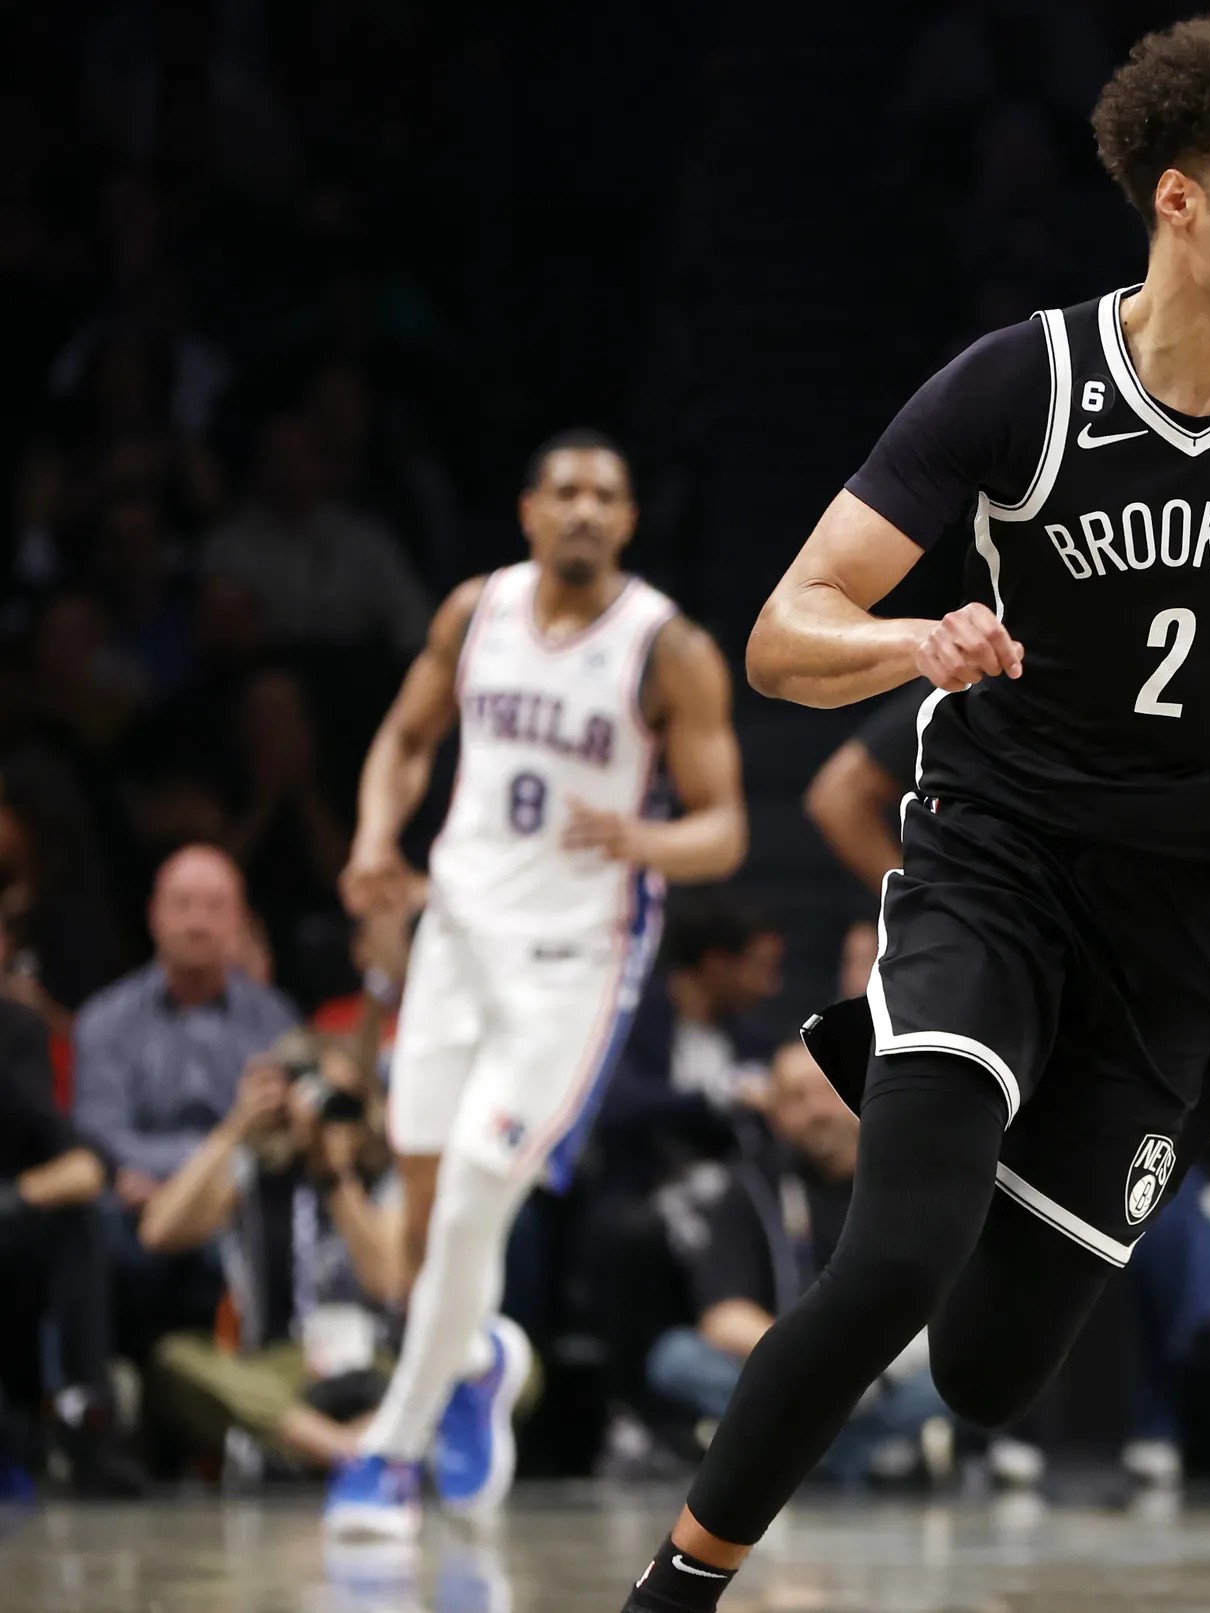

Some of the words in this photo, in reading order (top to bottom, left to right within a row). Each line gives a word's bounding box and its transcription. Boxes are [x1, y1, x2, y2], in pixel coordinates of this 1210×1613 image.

[1081, 381, 1106, 411] 6
[1133, 607, 1197, 718] 2
[509, 771, 547, 836] 8
[1134, 1139, 1172, 1186] NETS
